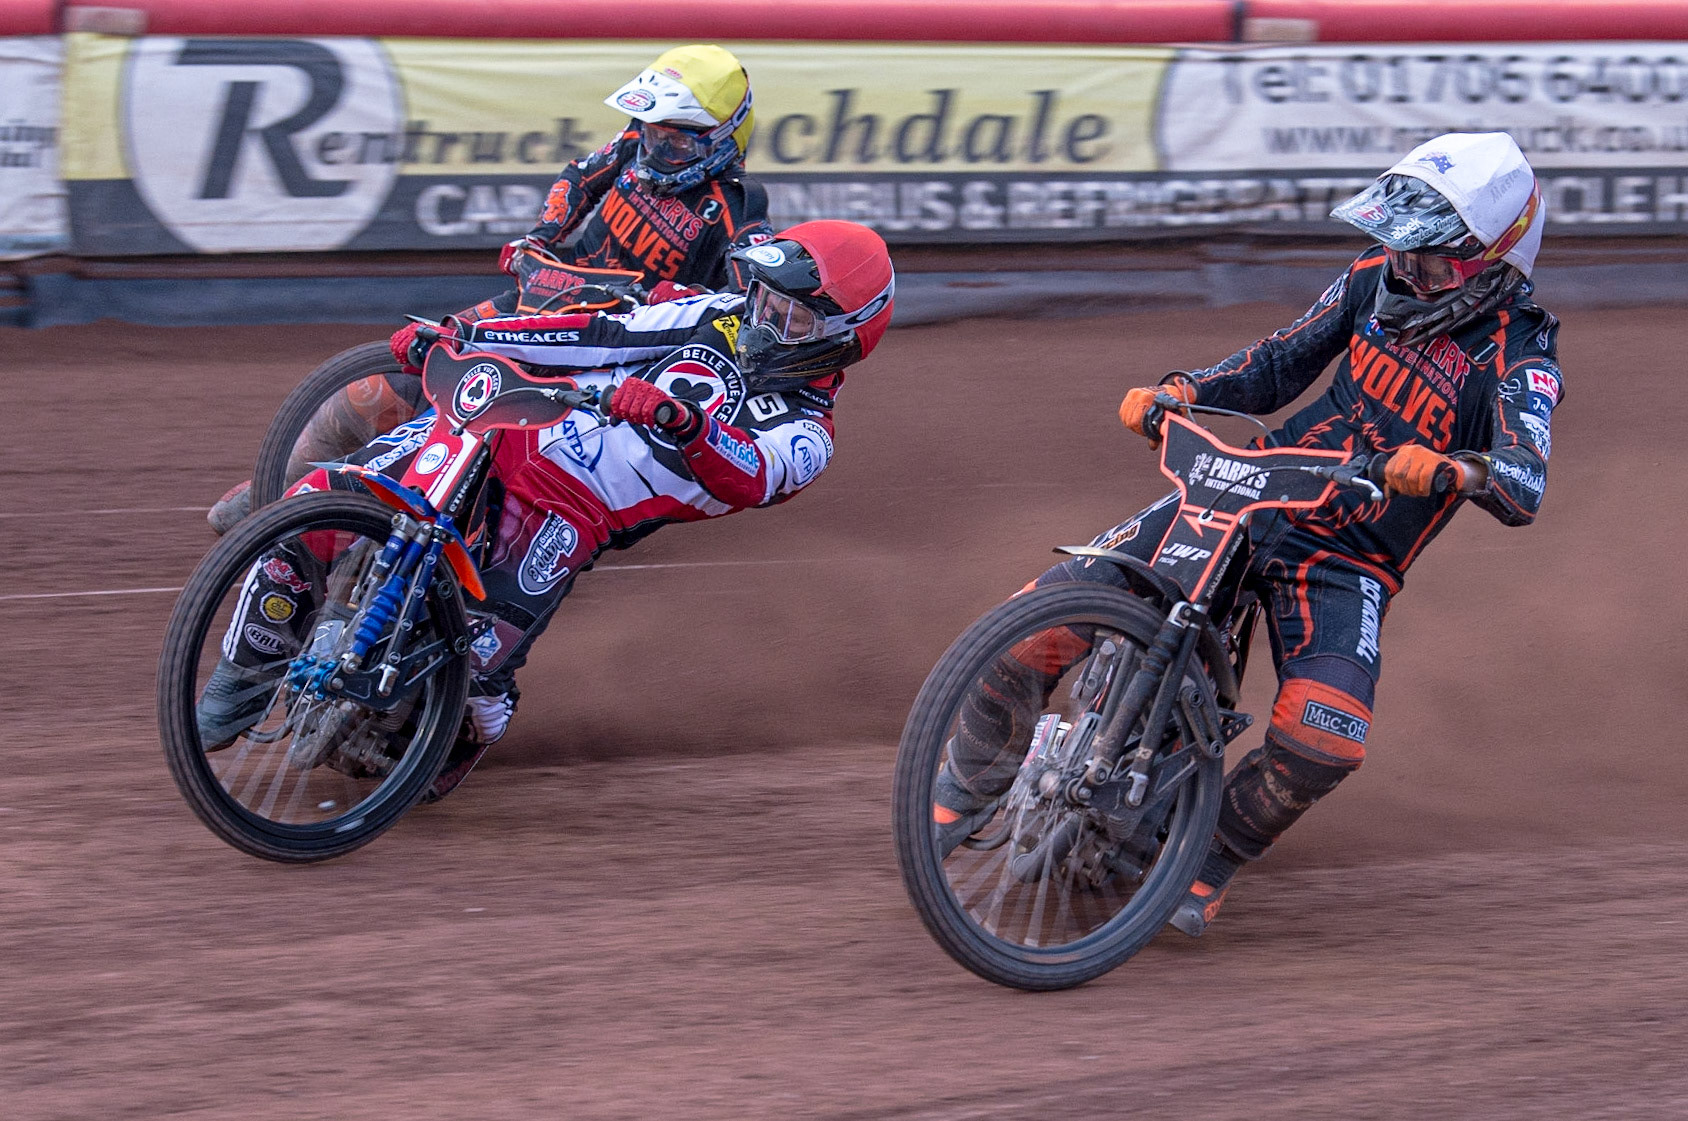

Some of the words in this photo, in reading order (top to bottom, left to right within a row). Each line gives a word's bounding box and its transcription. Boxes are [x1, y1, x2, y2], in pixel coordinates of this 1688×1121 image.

[752, 88, 1109, 165] chdale
[702, 199, 719, 219] 2
[600, 185, 686, 280] WOLVES
[1391, 217, 1425, 240] albek
[682, 349, 725, 372] BELLE
[725, 371, 741, 398] VUE
[1349, 333, 1456, 452] WOLVES
[716, 397, 738, 423] ACE
[1208, 457, 1271, 489] PARRYS
[1161, 542, 1212, 561] JWP
[1307, 706, 1368, 740] Muc-Off
